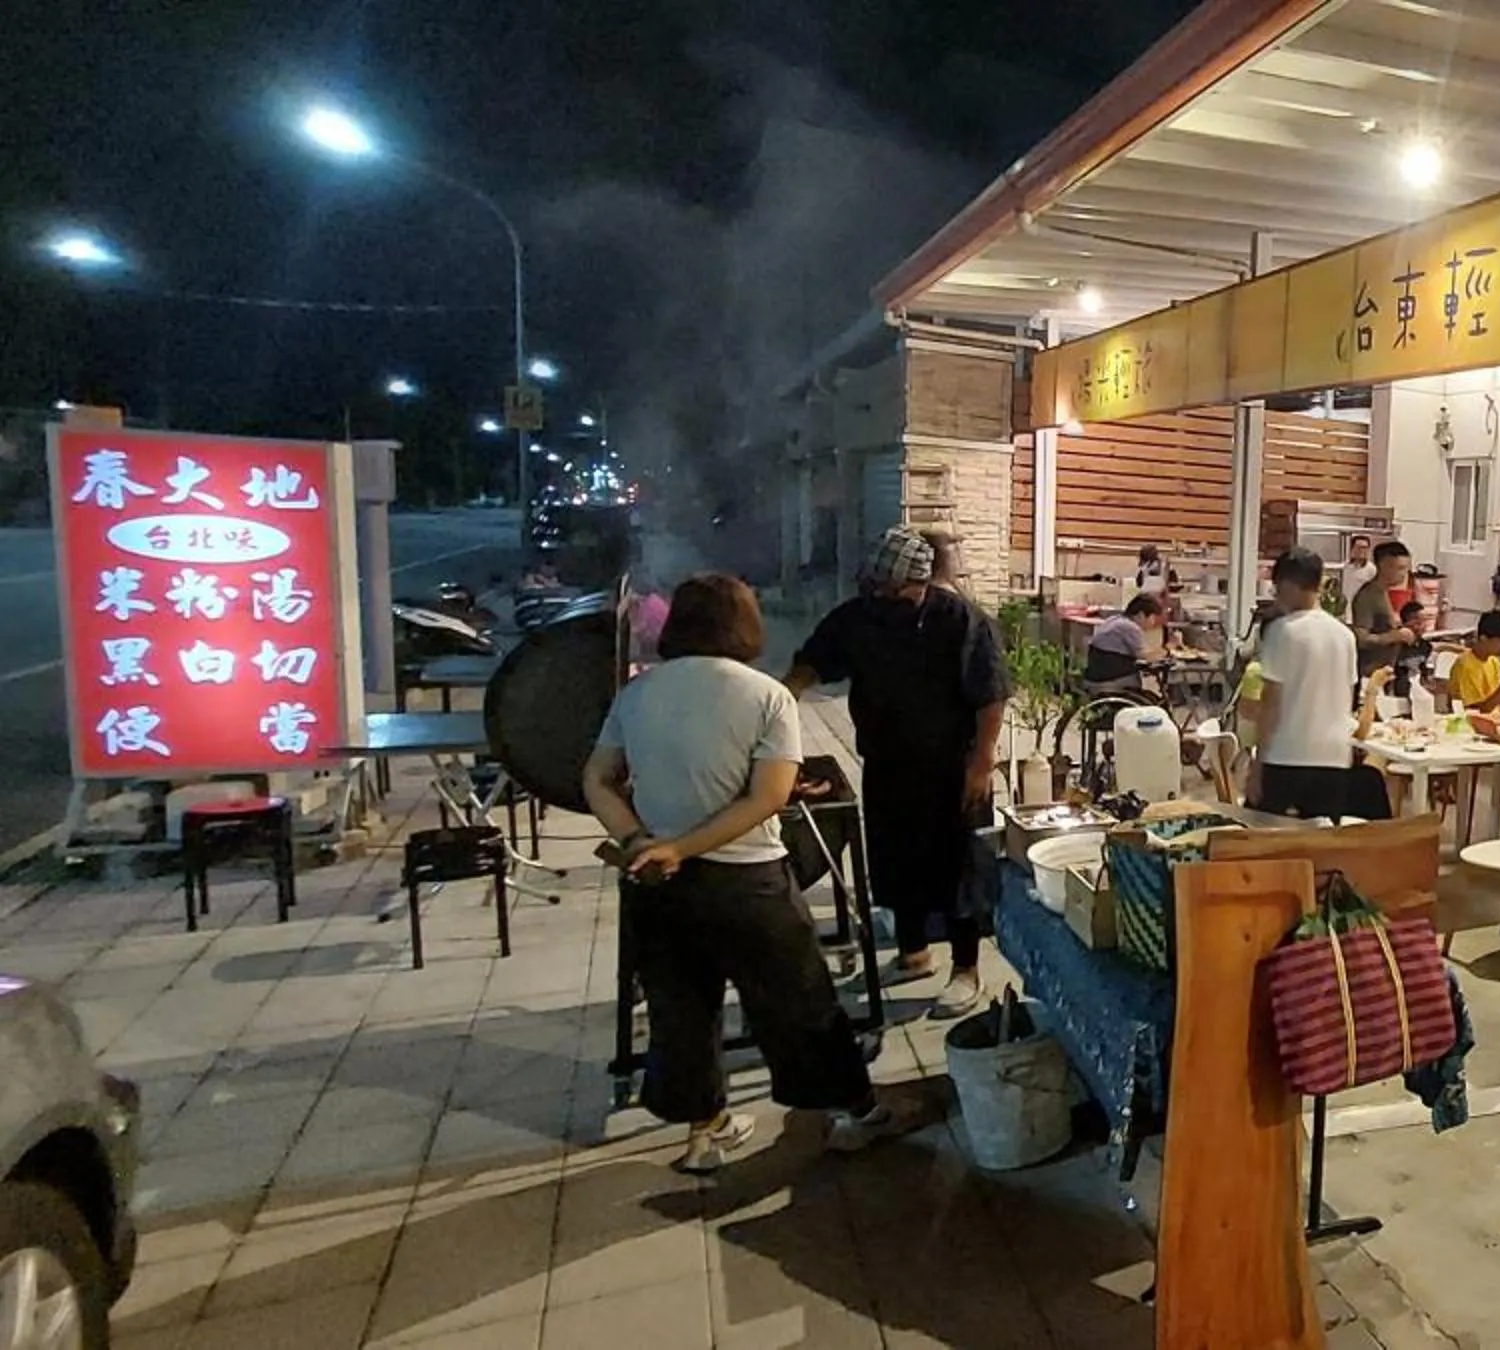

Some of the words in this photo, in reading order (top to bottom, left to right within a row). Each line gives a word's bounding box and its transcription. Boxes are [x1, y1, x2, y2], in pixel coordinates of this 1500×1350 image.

[72, 449, 319, 510] 春大地
[144, 525, 259, 551] 台北味
[96, 566, 313, 623] 米粉湯
[100, 637, 318, 687] 黑白切
[96, 702, 319, 757] 便當
